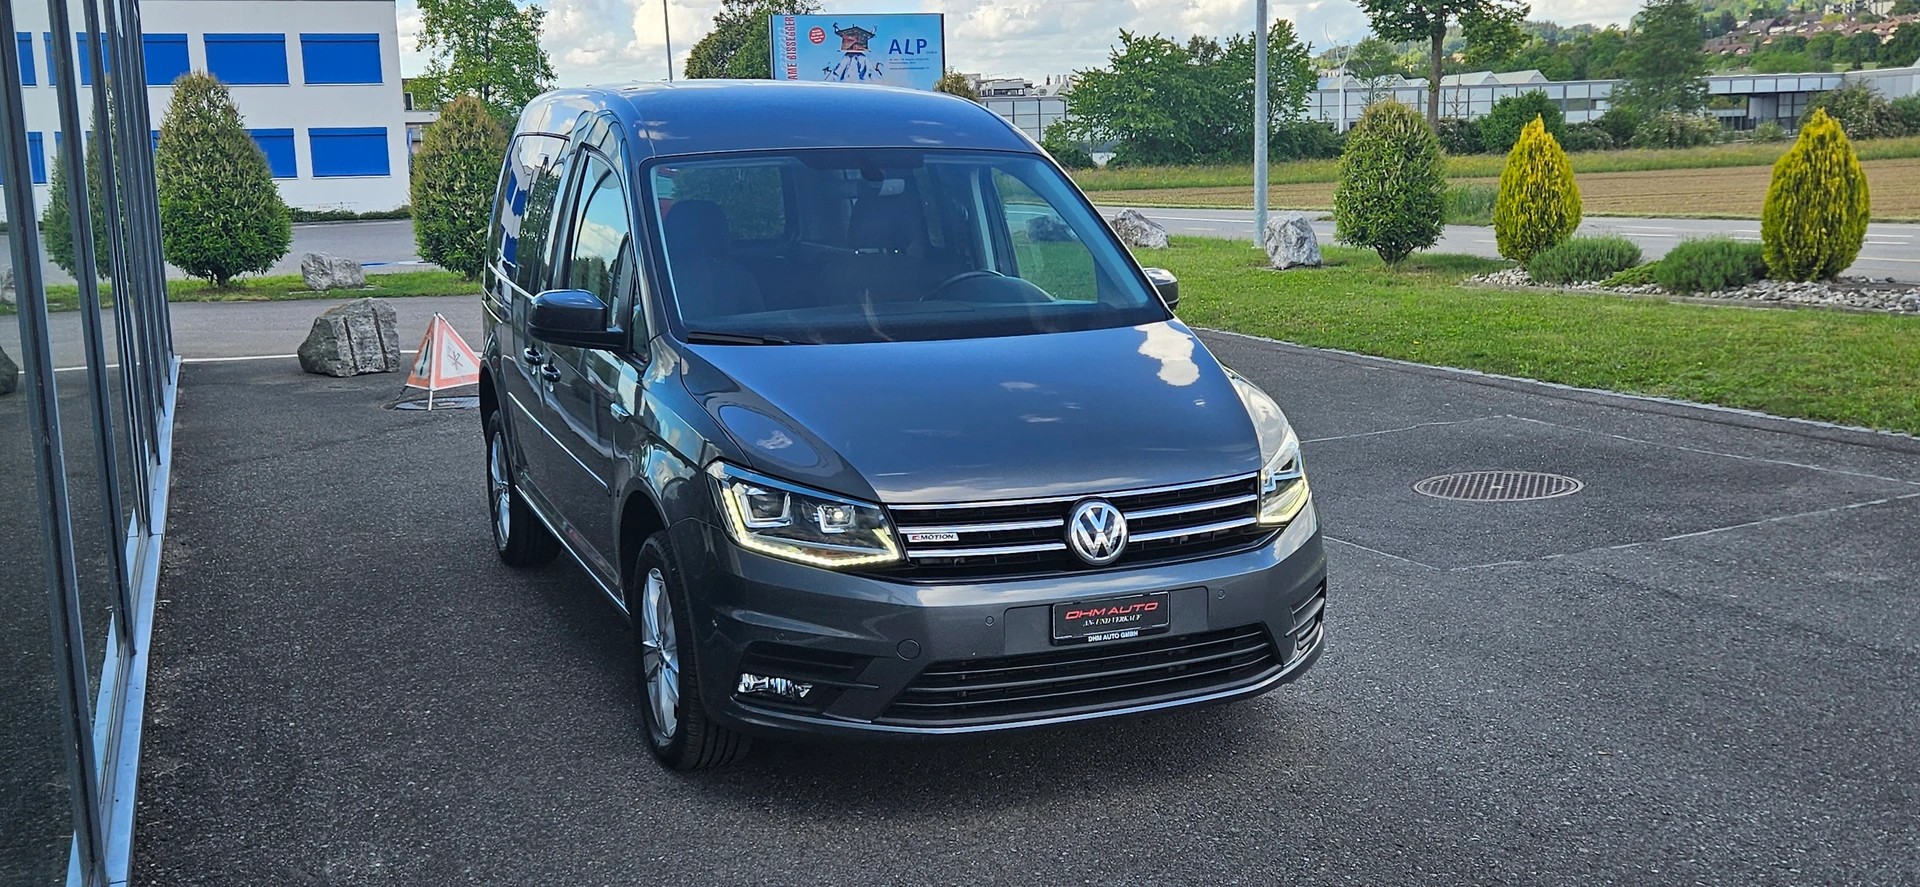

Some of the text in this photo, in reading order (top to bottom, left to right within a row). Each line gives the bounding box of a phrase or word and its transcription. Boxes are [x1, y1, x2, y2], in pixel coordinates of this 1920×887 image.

[785, 17, 796, 60] BISSEGGER
[888, 38, 928, 55] ALP
[1072, 502, 1126, 562] VW
[1107, 602, 1158, 615] AUTO
[1102, 632, 1120, 641] AUTO
